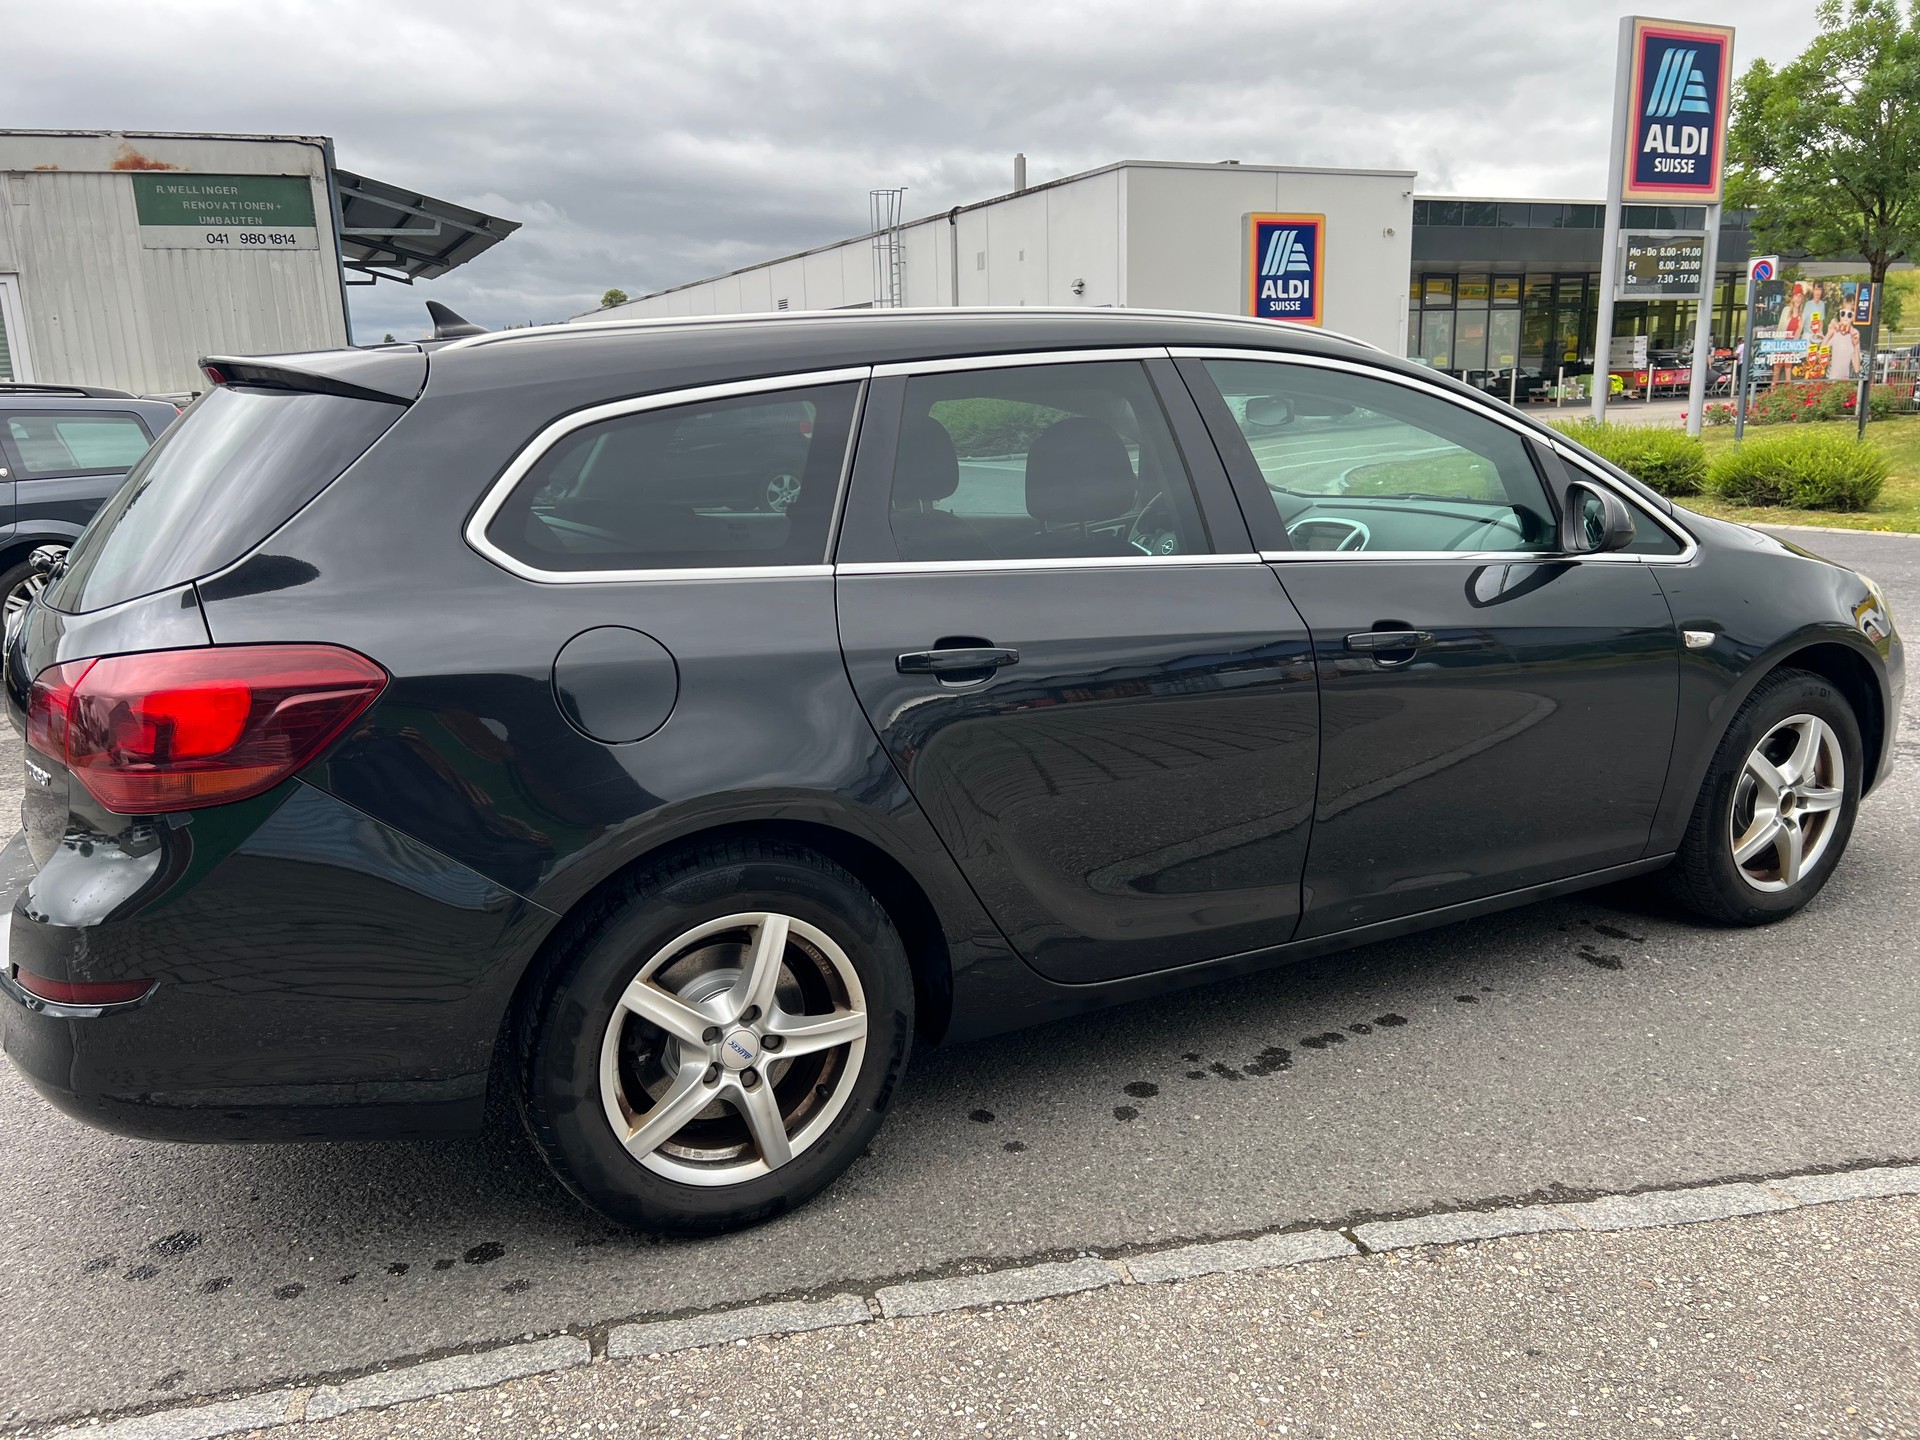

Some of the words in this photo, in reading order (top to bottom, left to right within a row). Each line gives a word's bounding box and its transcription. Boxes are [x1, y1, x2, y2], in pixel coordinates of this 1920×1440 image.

[1643, 124, 1709, 155] ALDI
[1653, 157, 1696, 173] SUISSE
[167, 185, 238, 195] WELLINGER
[198, 216, 263, 225] UMBAUTEN
[206, 233, 229, 244] 041
[1628, 261, 1637, 270] Fr
[1658, 261, 1675, 270] 8.00
[1680, 261, 1700, 270] 20.00
[1627, 274, 1637, 284] Sa
[1657, 274, 1673, 283] 7.30
[1680, 274, 1699, 283] 17.00
[1261, 279, 1310, 299] ALDI
[1269, 301, 1301, 311] SUISSE
[1760, 340, 1807, 352] GRILLGENUSS
